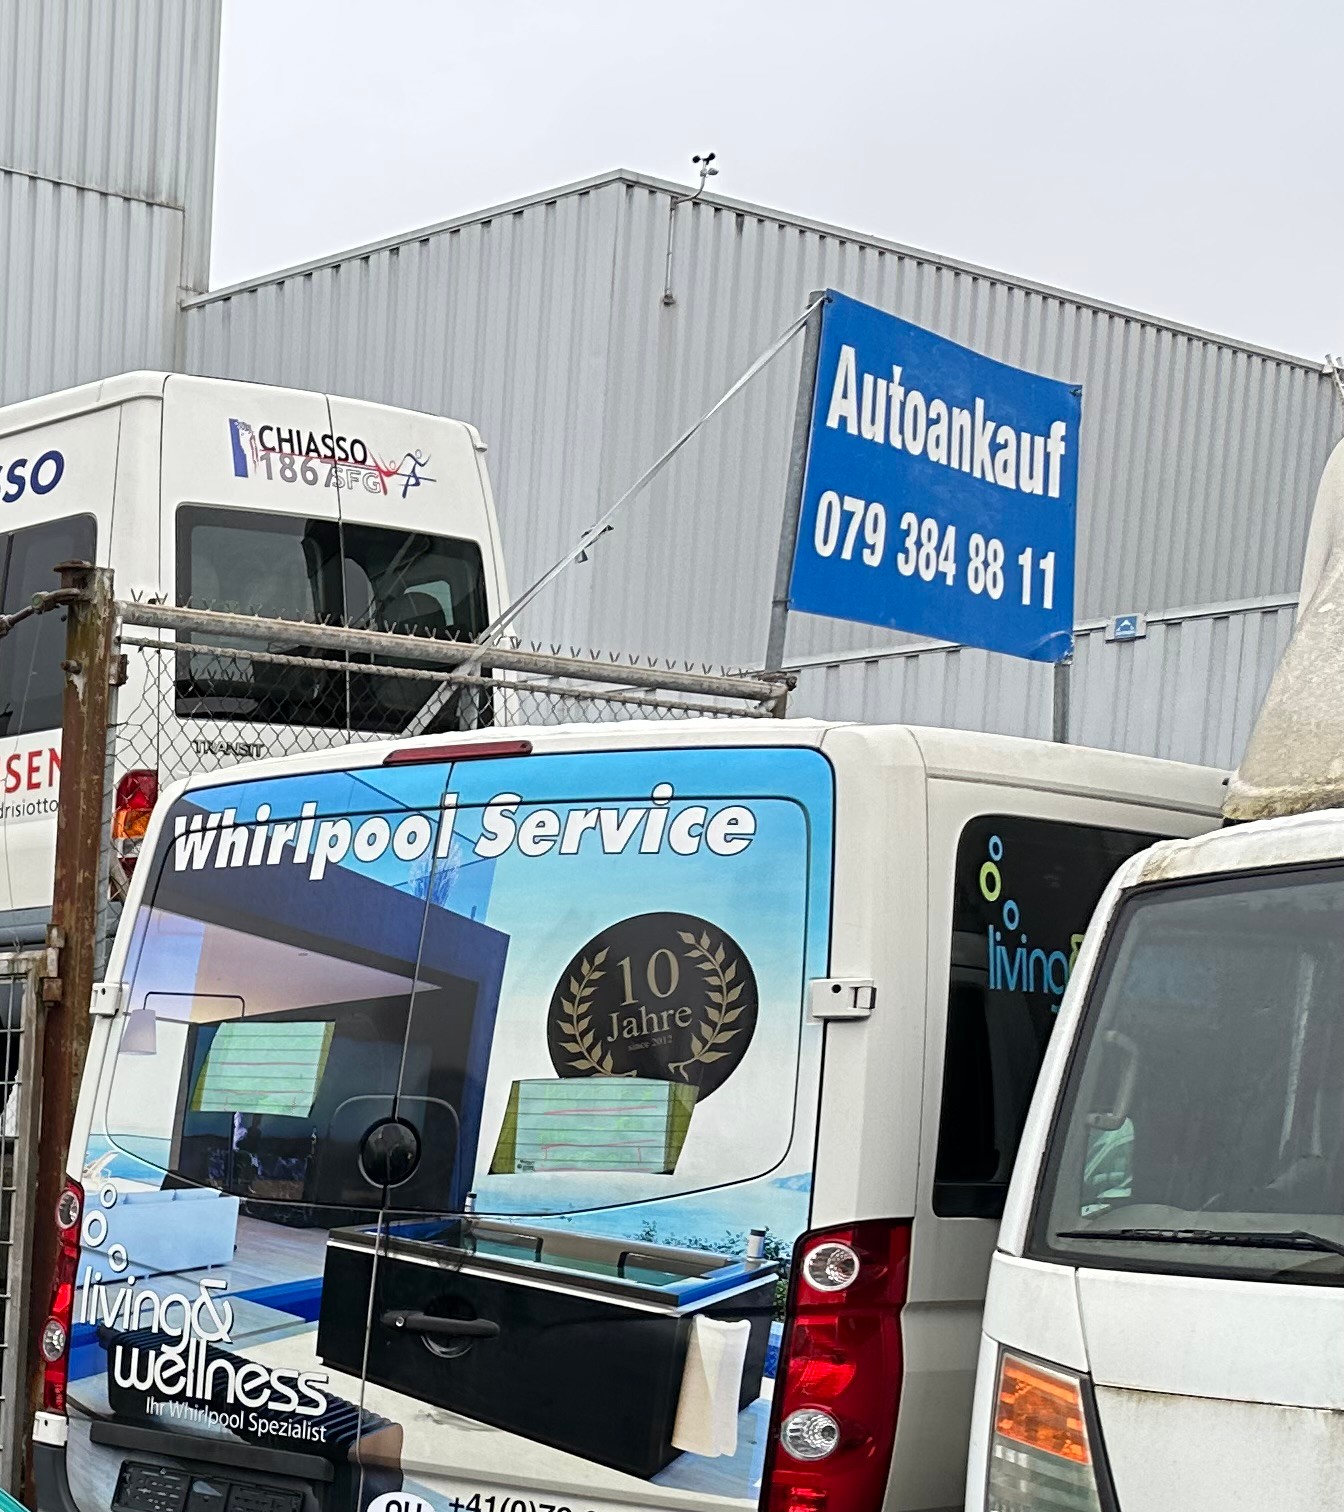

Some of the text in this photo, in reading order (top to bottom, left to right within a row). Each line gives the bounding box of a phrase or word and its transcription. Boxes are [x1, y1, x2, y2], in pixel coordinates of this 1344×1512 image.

[258, 425, 368, 465] CHIASSO
[826, 343, 1067, 499] Autoankauf
[260, 452, 336, 488] 1867
[814, 490, 1056, 610] 079 384 88 11
[192, 739, 265, 758] TRANSIT
[174, 781, 758, 881] Whirlpool Service
[616, 948, 680, 1007] 10
[607, 1005, 693, 1042] Jahre
[113, 1337, 329, 1416] wellness
[146, 1396, 328, 1443] Ihr Whirlpool Spezialist
